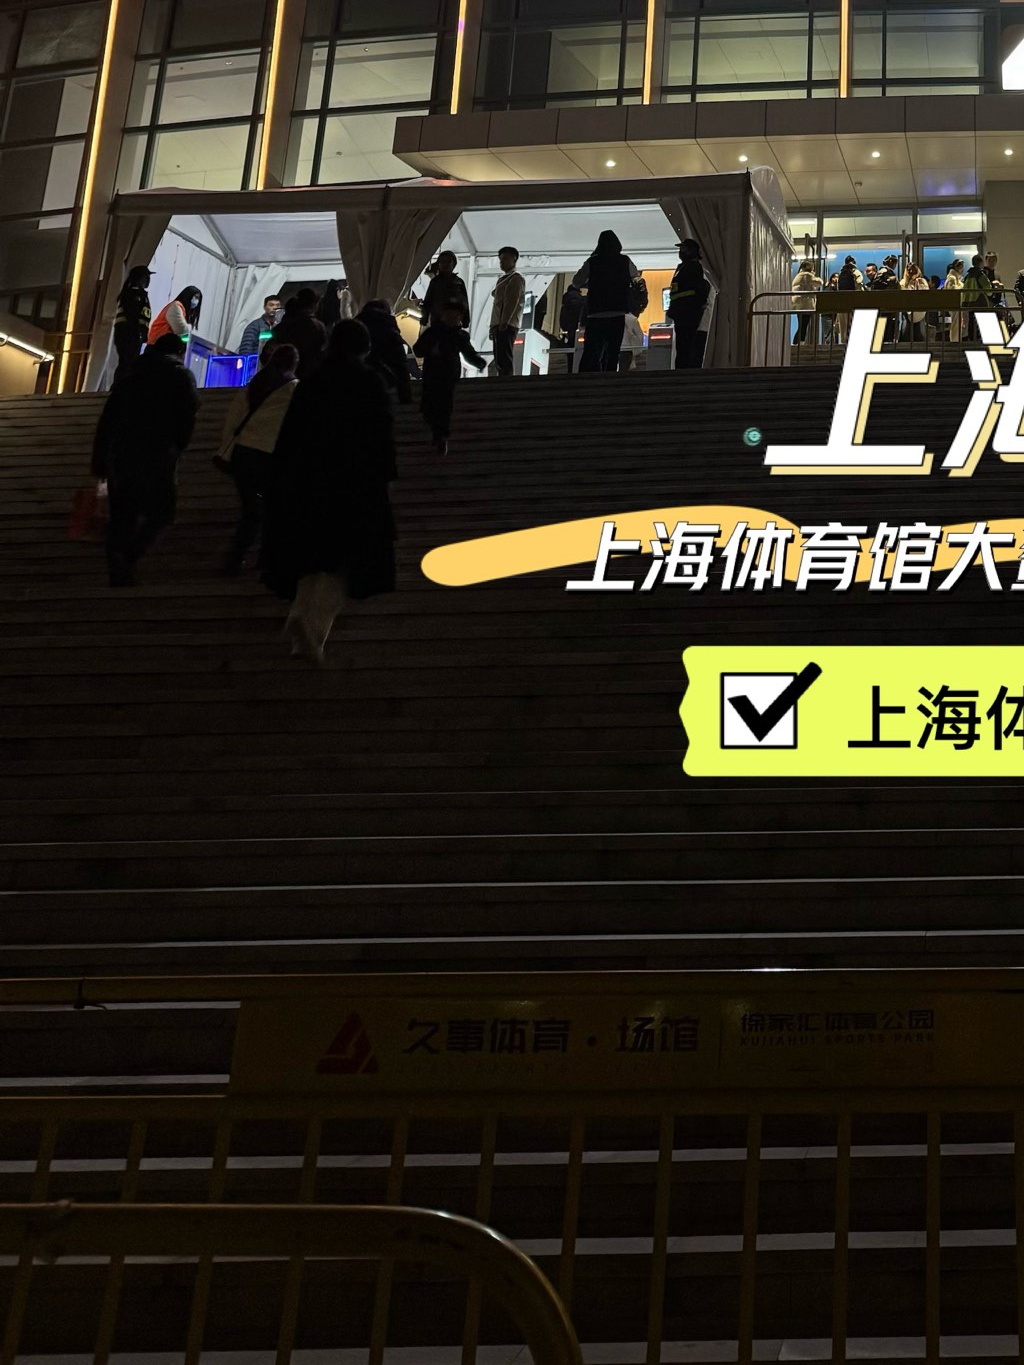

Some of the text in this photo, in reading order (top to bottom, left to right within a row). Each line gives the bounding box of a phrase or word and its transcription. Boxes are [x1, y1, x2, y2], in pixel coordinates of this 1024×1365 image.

[740, 1009, 935, 1033] 徐家汇体育公园
